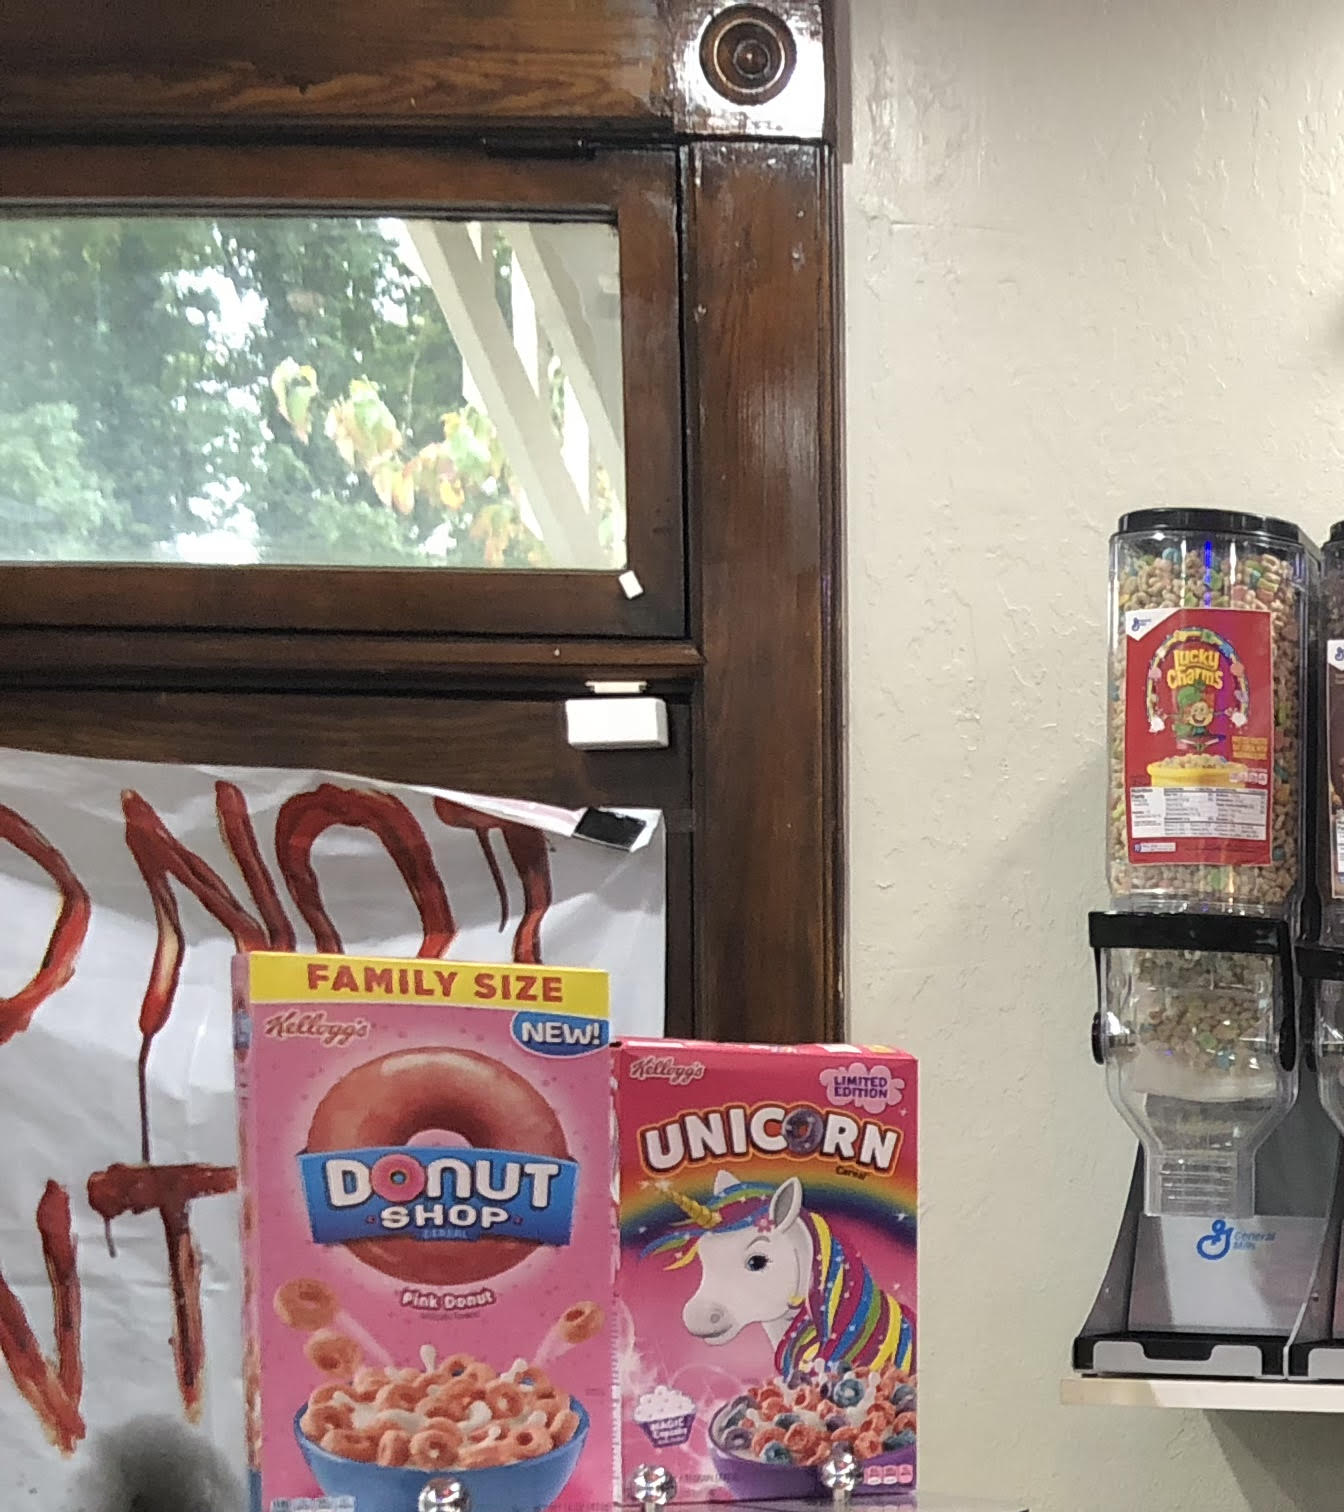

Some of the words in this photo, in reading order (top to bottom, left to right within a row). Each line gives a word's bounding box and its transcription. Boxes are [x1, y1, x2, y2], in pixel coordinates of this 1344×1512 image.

[1174, 650, 1219, 667] Lucky
[1167, 666, 1224, 690] Charms
[308, 964, 458, 997] FAMILY
[474, 972, 563, 1002] SIZE
[266, 1011, 370, 1047] Kellogg's
[521, 1022, 601, 1044] NEW!
[630, 1057, 704, 1085] Kellogg's
[834, 1076, 887, 1088] LIMITED
[834, 1087, 888, 1098] EDITION
[645, 1106, 898, 1171] UNICORN
[327, 1158, 561, 1207] DONUT
[381, 1206, 509, 1228] SHOP
[402, 1291, 439, 1308] Pink
[444, 1291, 494, 1309] Donut
